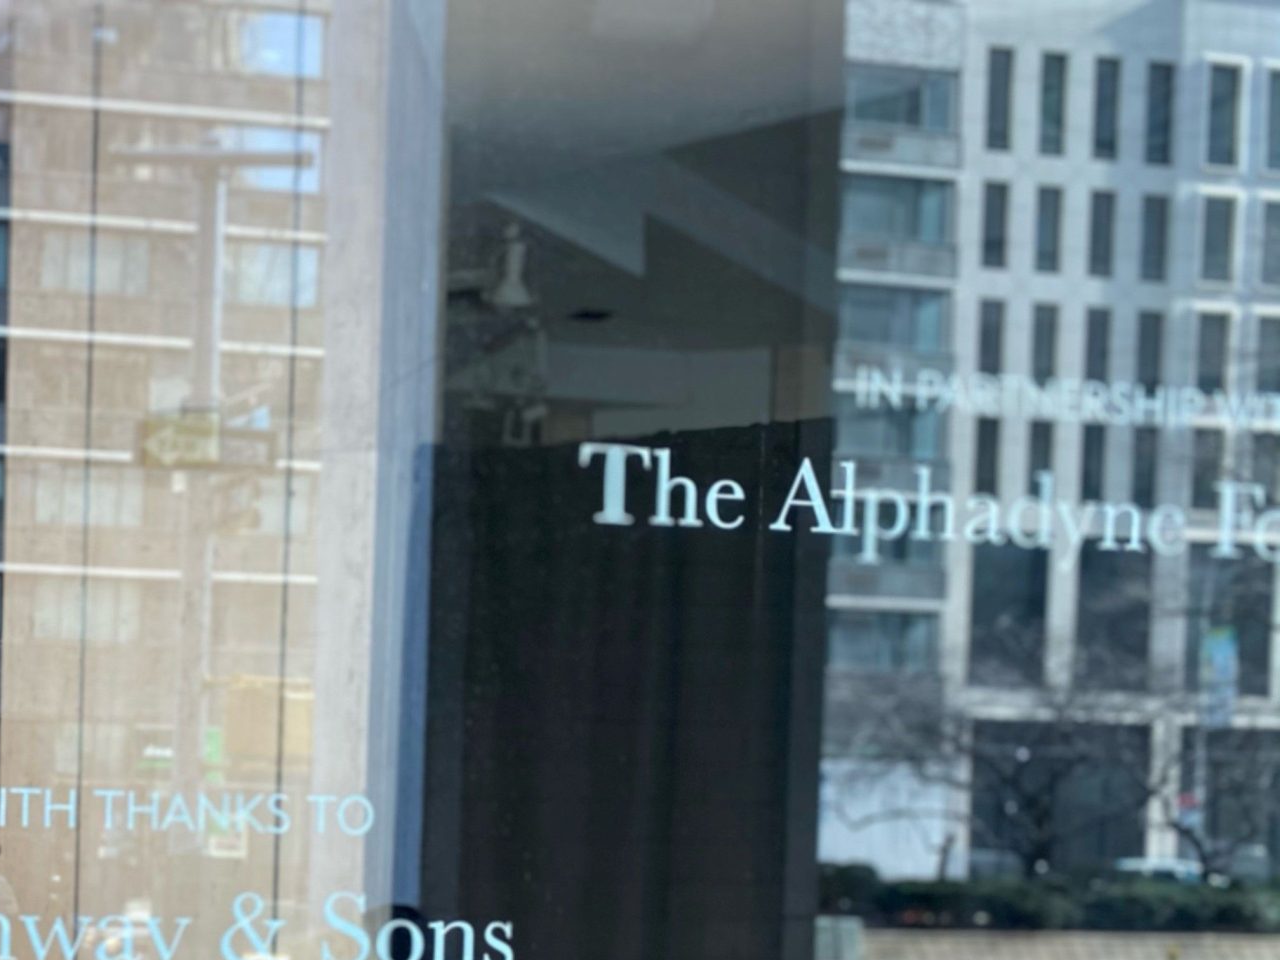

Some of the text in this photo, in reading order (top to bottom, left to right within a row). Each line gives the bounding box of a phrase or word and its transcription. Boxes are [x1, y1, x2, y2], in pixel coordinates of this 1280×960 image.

[856, 365, 901, 410] IN
[917, 369, 1206, 427] PARTNERSHIP
[578, 442, 745, 529] The
[769, 458, 1185, 570] Alphadyne
[94, 787, 291, 836] THANKS
[307, 793, 375, 837] TO
